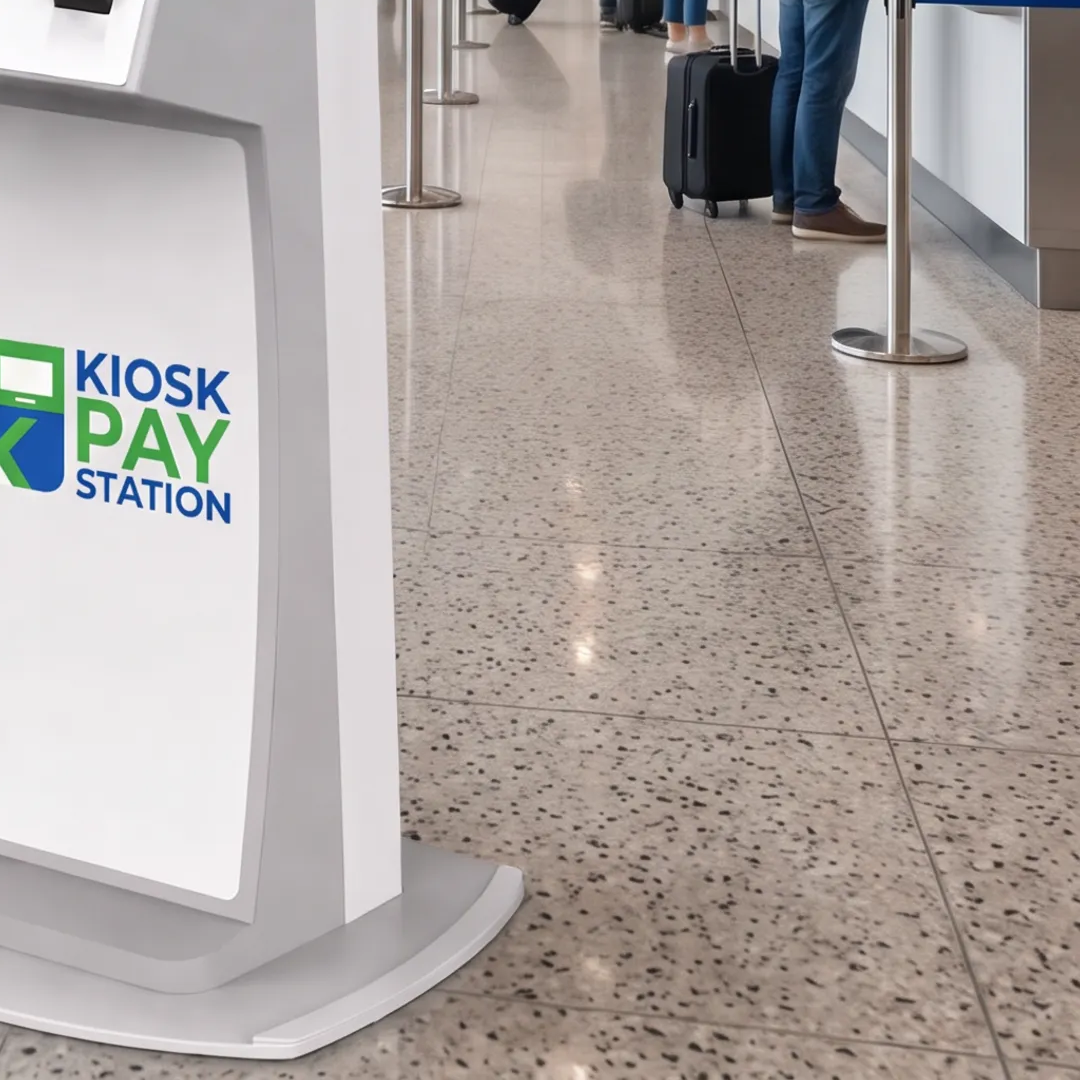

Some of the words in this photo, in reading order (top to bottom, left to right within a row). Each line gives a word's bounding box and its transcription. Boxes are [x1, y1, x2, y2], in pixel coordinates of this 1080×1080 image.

[76, 349, 231, 415] KIOSK
[76, 396, 231, 484] PAY
[76, 468, 231, 524] STATION
